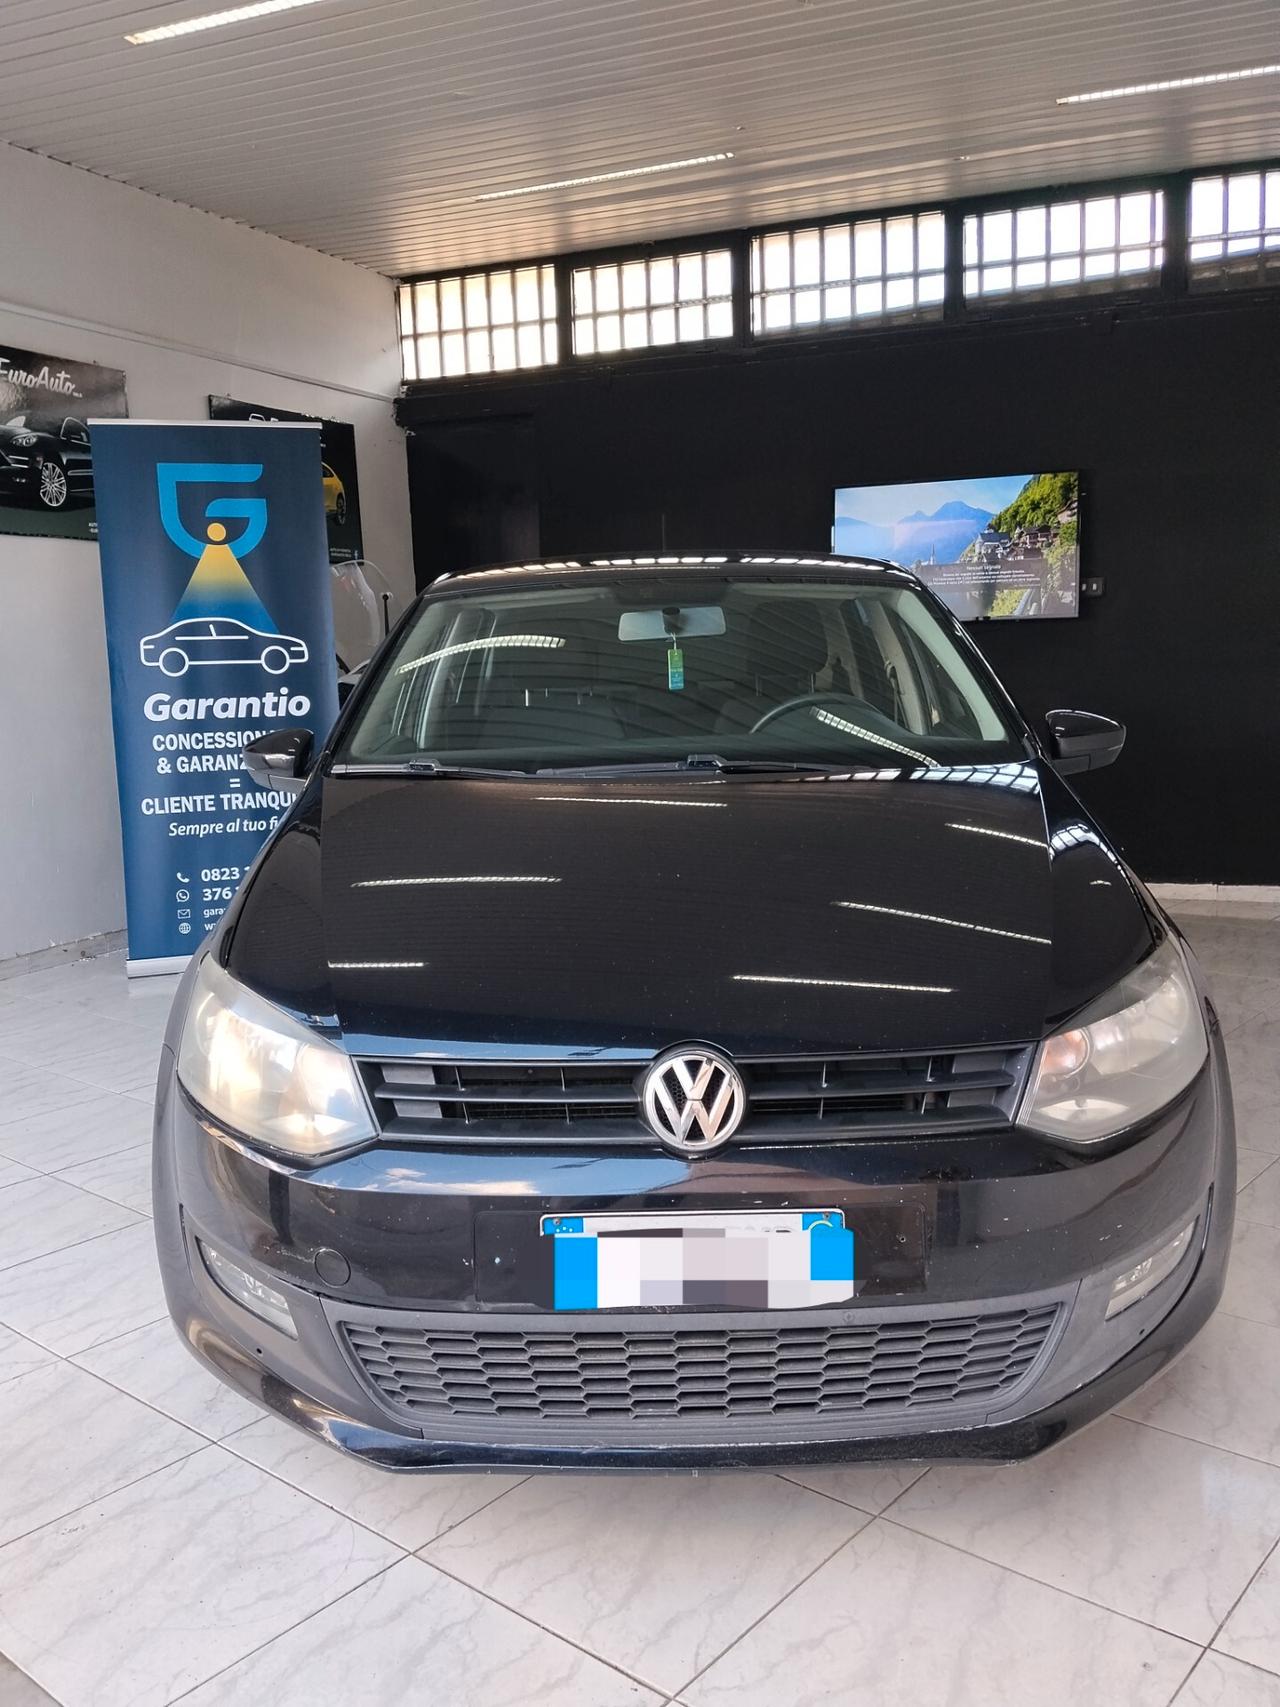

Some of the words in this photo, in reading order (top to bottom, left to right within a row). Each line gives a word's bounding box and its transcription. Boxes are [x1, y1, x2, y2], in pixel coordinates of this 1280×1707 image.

[143, 687, 311, 721] Garantio
[152, 730, 276, 751] CONCESSIO
[157, 757, 171, 774] &
[177, 754, 248, 773] GARANZ
[141, 795, 216, 815] CLIENTE
[168, 822, 224, 838] Sempre
[226, 818, 240, 833] al
[243, 819, 267, 832] tuo
[269, 816, 280, 831] fi
[201, 867, 240, 881] 0823
[202, 887, 232, 901] 376
[203, 907, 226, 918] gara
